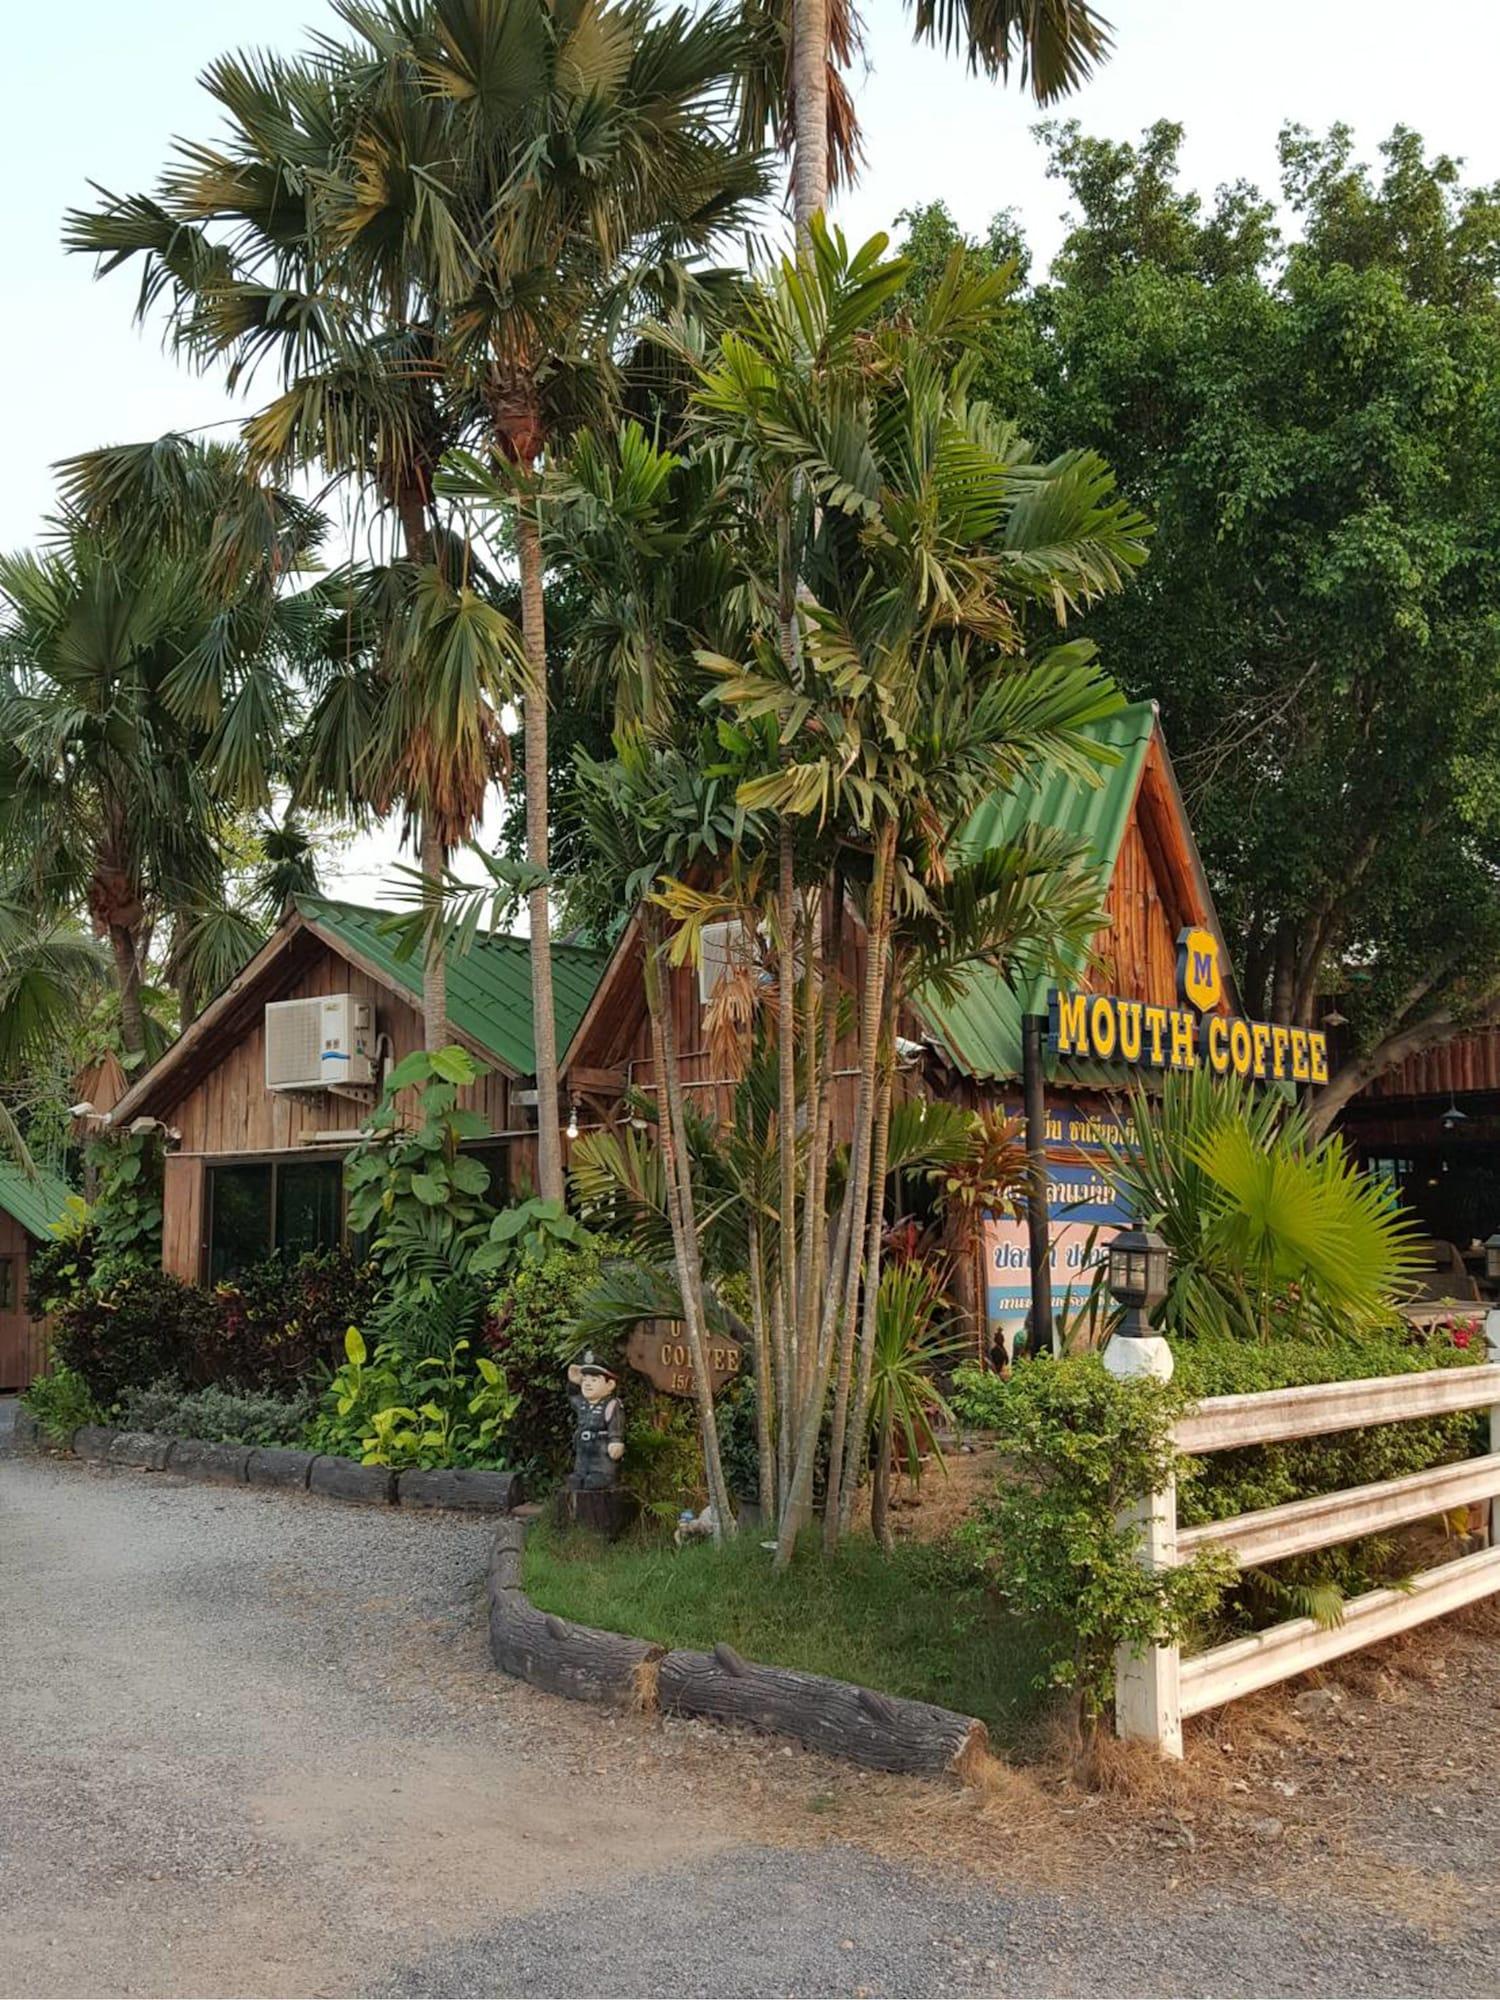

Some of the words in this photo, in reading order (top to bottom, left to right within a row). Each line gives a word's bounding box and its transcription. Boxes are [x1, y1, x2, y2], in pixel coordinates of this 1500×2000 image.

[1193, 951, 1213, 988] M
[1057, 991, 1196, 1069] MOUTH
[1208, 1015, 1330, 1083] COFFEE
